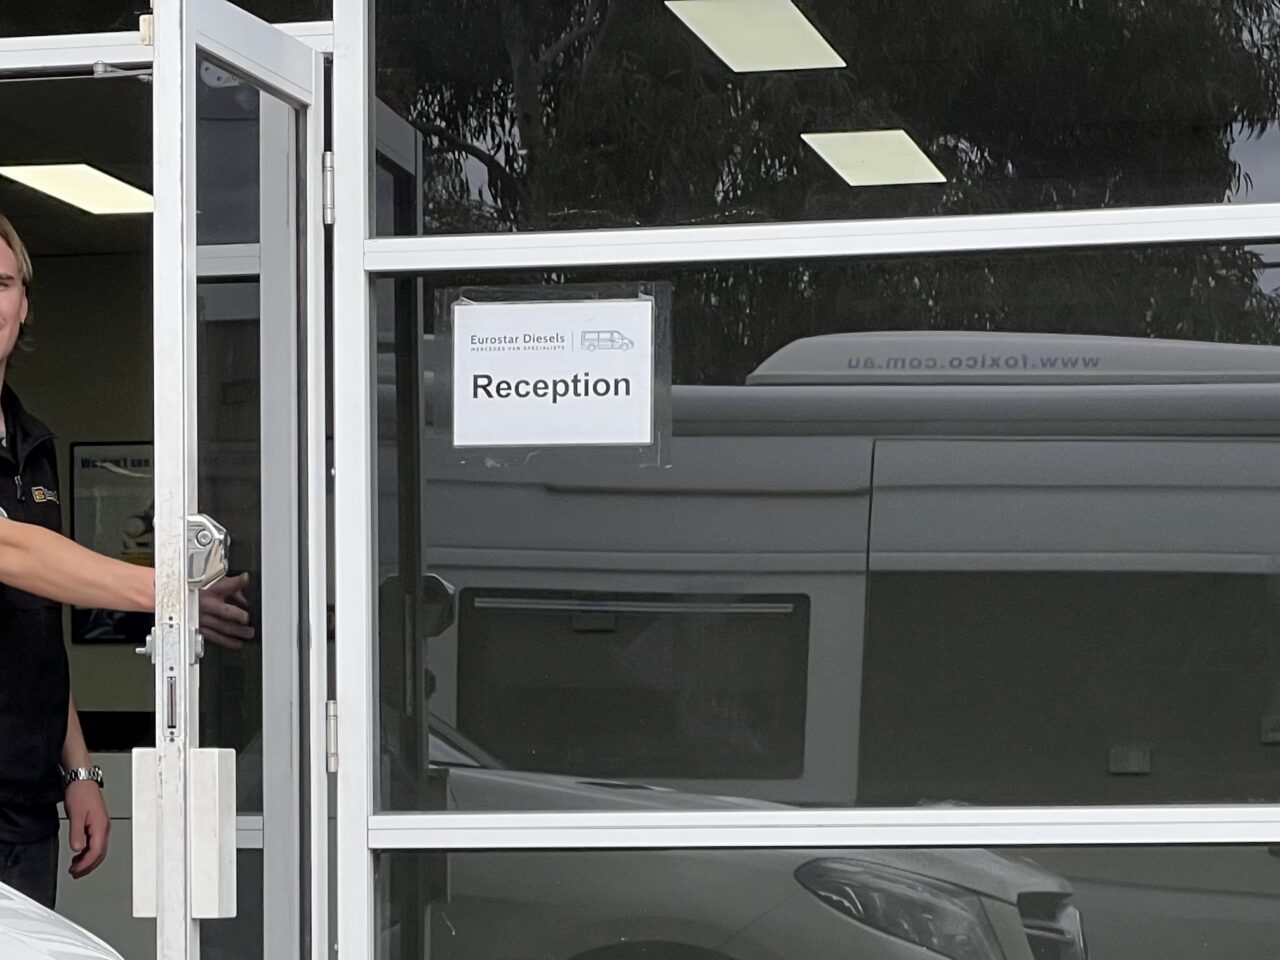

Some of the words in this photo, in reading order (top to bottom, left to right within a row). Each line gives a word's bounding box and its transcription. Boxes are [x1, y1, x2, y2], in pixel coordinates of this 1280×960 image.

[470, 334, 519, 345] Eurostar
[523, 332, 565, 344] Diesels
[472, 371, 631, 404] Reception
